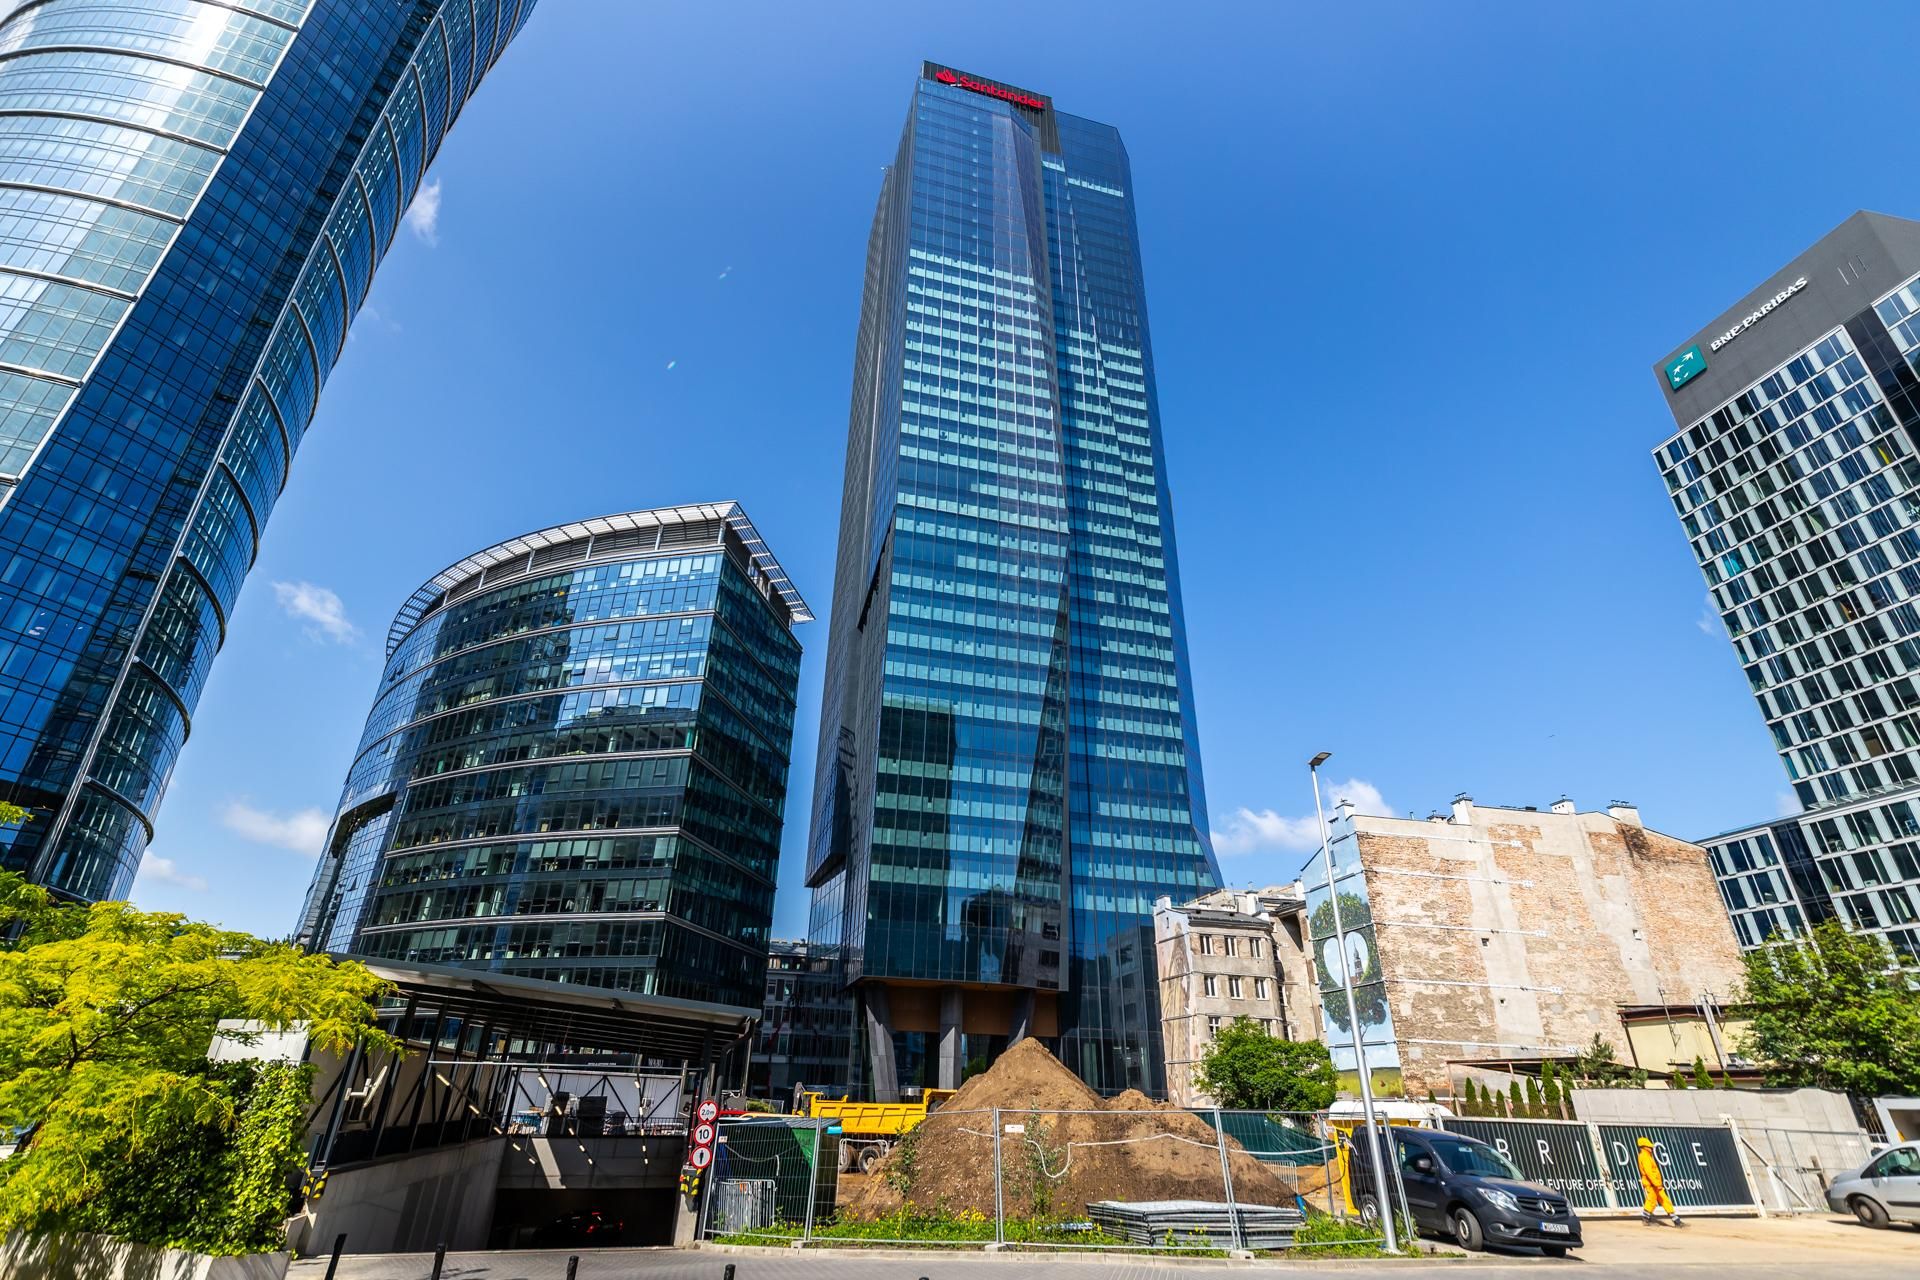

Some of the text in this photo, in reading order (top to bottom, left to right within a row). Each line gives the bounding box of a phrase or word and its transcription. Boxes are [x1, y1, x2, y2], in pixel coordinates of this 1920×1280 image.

[960, 76, 1045, 109] Santander
[1710, 277, 1808, 351] BNP PARIBAS
[699, 1129, 710, 1140] 10
[1548, 1179, 1584, 1191] FUTURE
[1586, 1179, 1625, 1191] OFFCE
[1626, 1179, 1638, 1190] IN
[1663, 1179, 1703, 1191] OCATION
